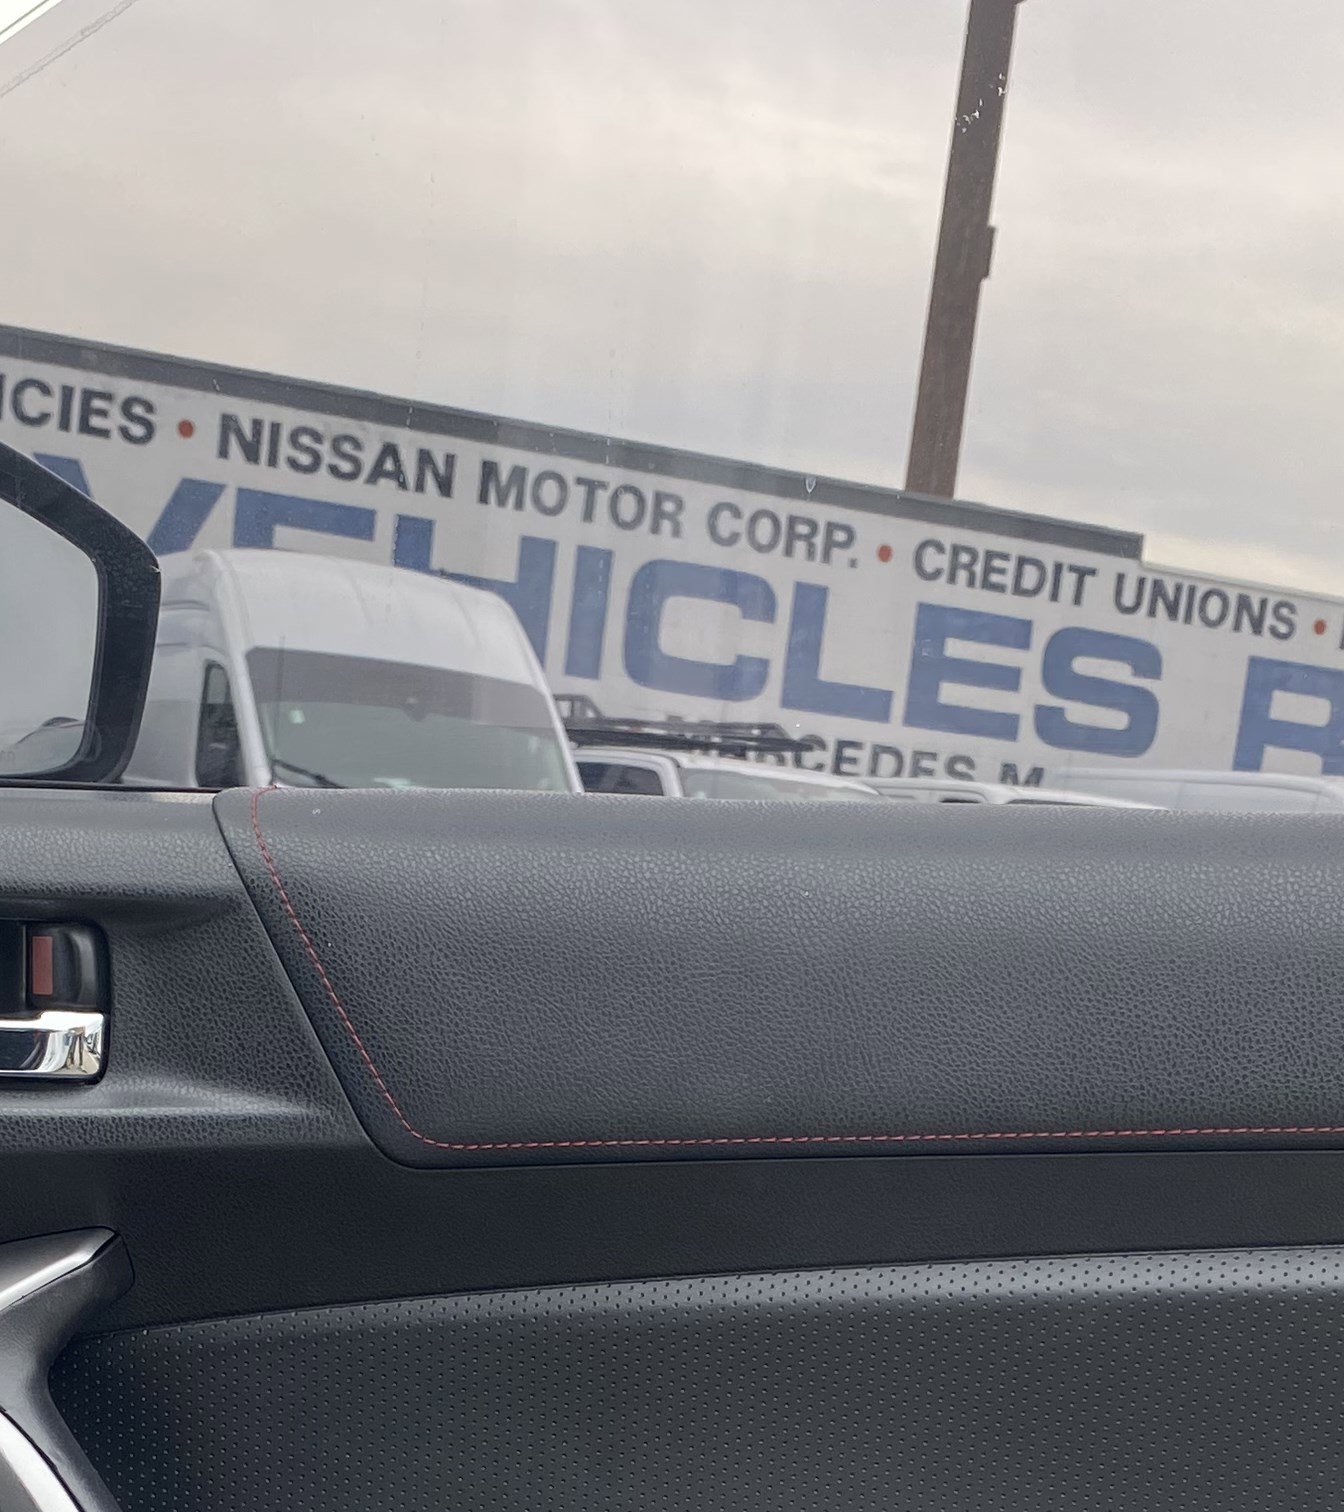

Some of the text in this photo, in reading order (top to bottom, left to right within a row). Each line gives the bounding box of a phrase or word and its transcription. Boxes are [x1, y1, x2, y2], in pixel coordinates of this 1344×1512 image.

[215, 411, 458, 499] NISSAN
[477, 459, 686, 540] MOTOR
[705, 501, 859, 570] CORP.
[912, 538, 1098, 606] CREDIT
[1112, 571, 1299, 641] UNIONS
[682, 729, 977, 783] CEDES
